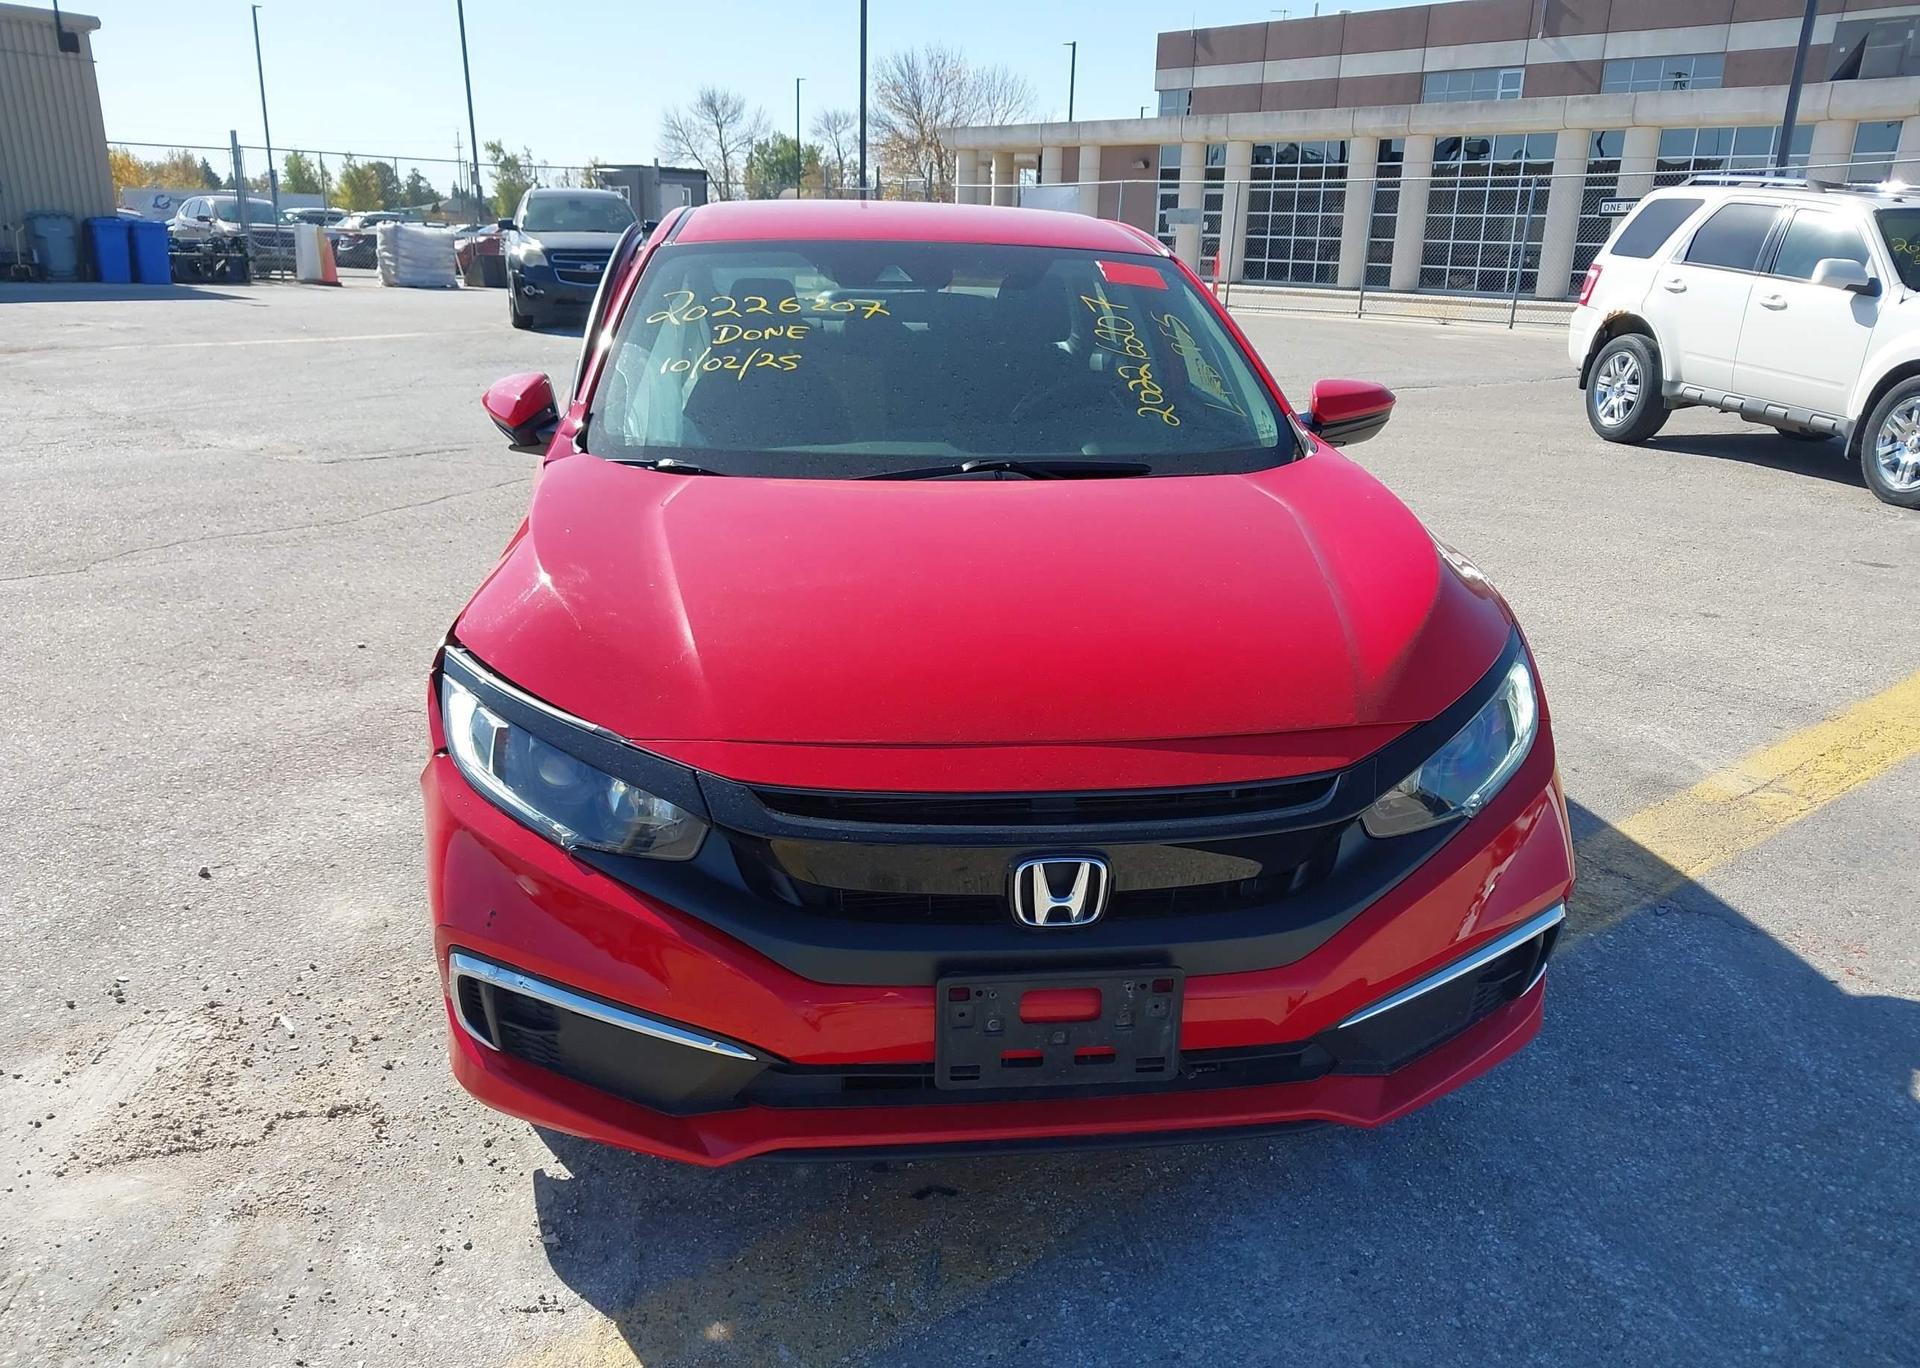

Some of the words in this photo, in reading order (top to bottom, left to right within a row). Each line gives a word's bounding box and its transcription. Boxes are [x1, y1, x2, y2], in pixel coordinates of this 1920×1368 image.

[1603, 203, 1622, 212] ONE
[645, 290, 891, 325] 20226207
[711, 324, 810, 345] DONE
[660, 346, 802, 381] 10/02/25
